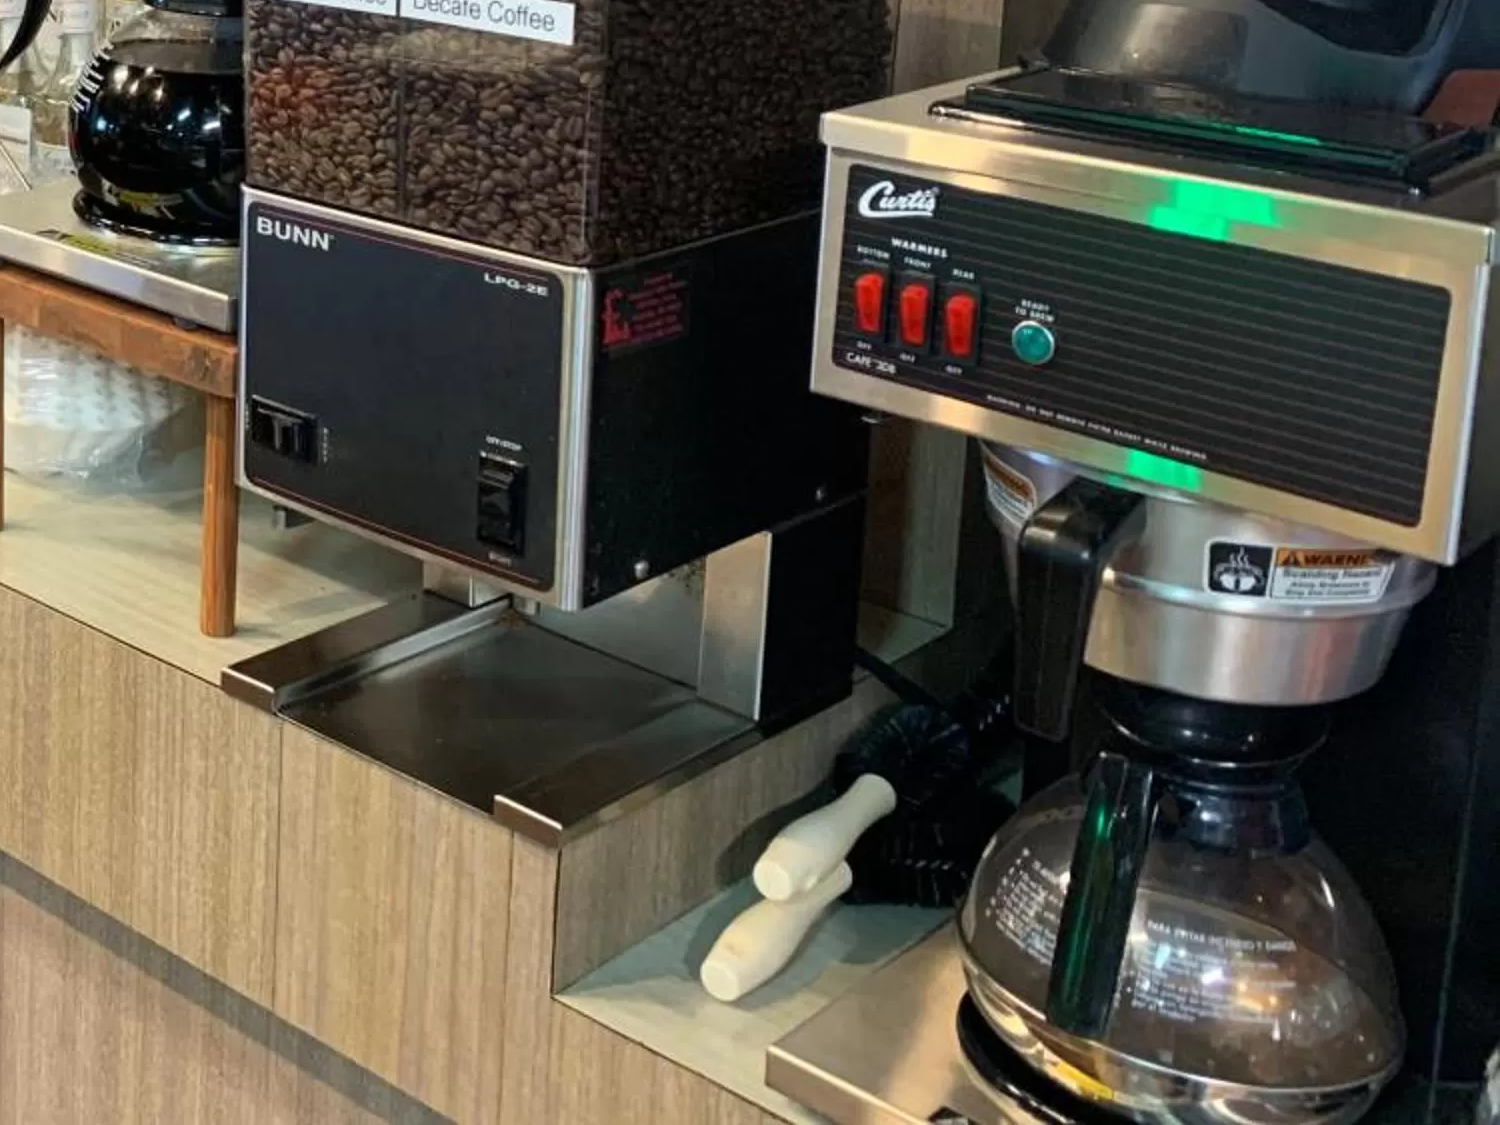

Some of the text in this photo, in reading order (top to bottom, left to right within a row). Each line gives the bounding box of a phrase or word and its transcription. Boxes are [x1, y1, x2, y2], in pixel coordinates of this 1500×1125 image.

[487, 0, 556, 32] Coffee
[858, 180, 937, 218] Curtis
[256, 216, 330, 251] BUNN
[891, 237, 949, 259] WARMERS
[483, 272, 549, 296] LPG-2E
[1303, 553, 1369, 568] WARNI
